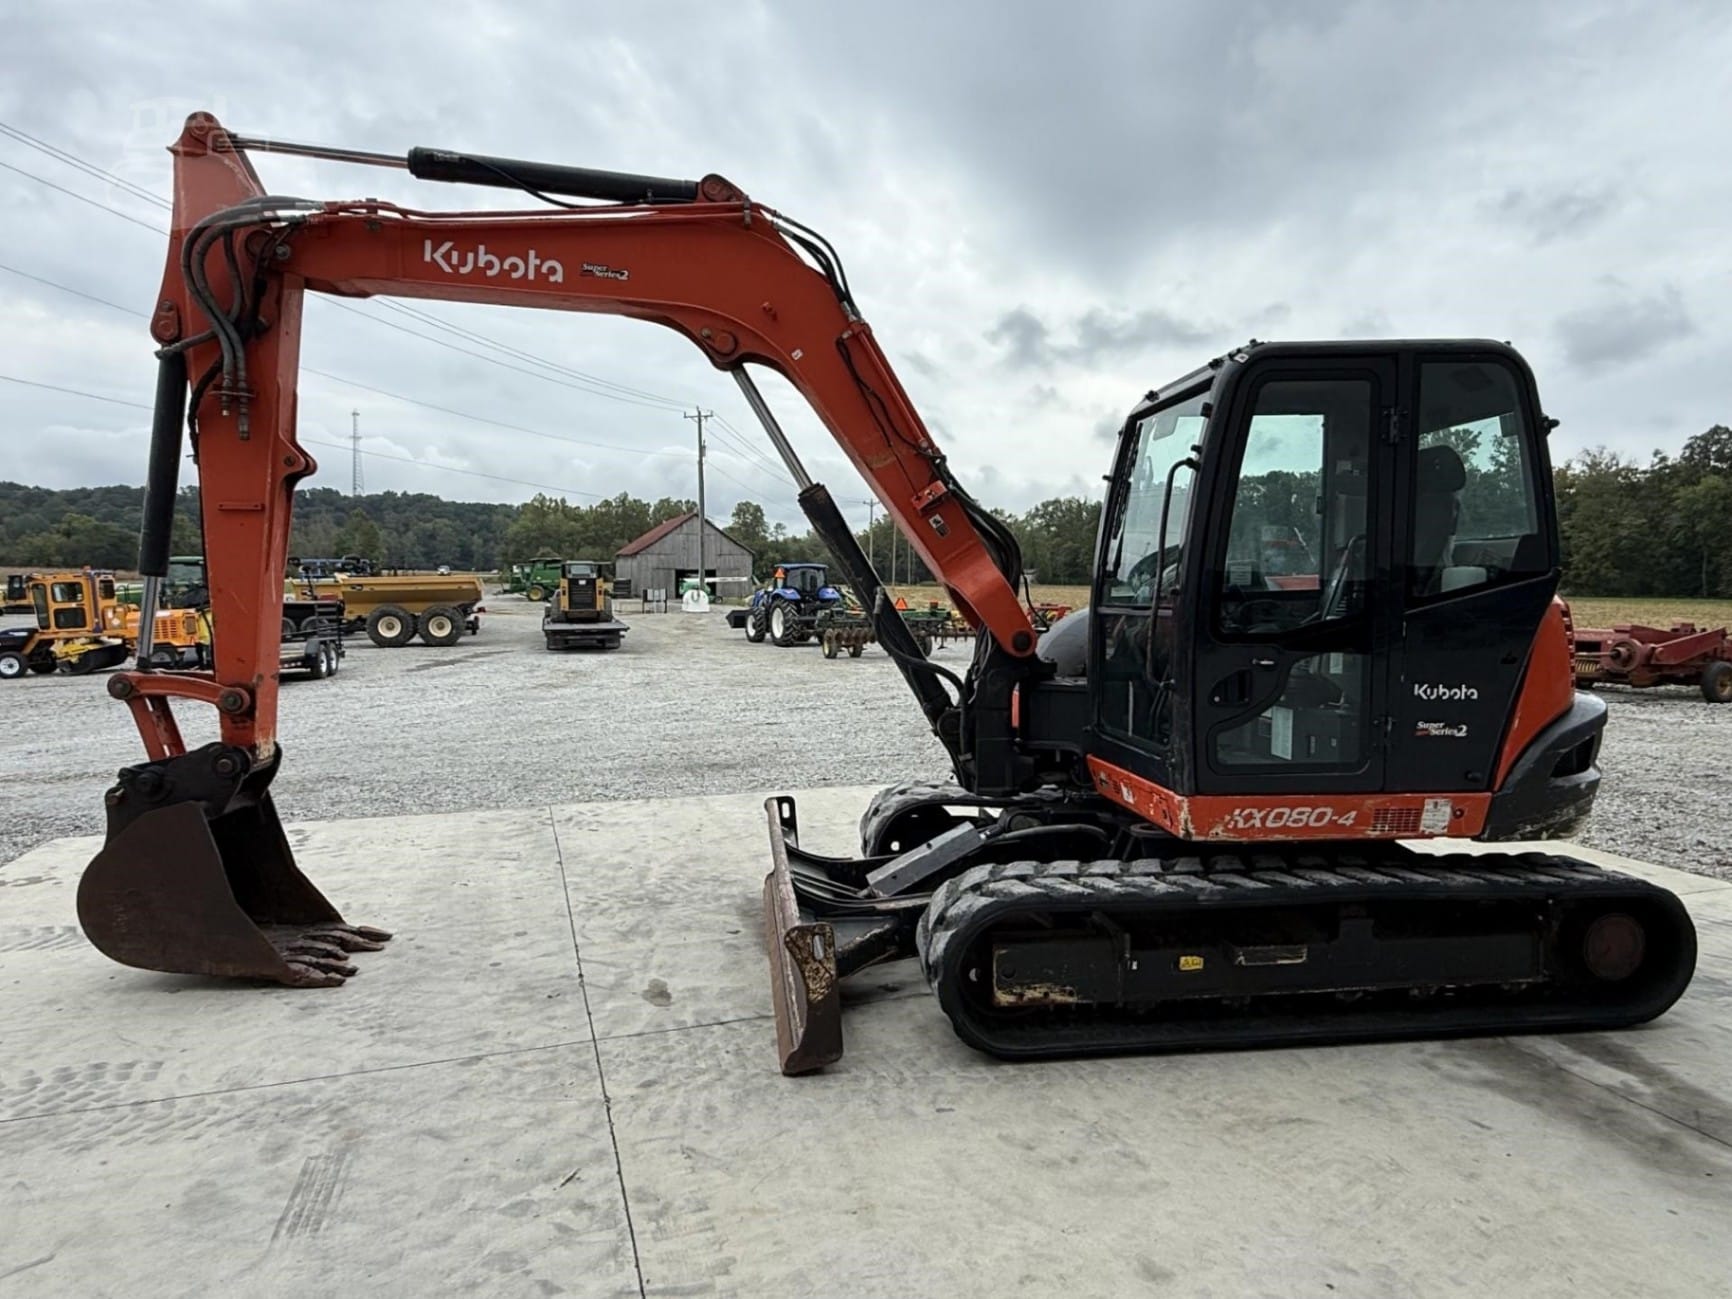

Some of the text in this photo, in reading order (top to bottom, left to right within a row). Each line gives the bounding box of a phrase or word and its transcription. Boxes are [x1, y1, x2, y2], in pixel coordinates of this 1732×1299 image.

[424, 239, 563, 283] Kubota
[1414, 684, 1478, 700] Kubota
[1228, 807, 1357, 829] KX080-4
